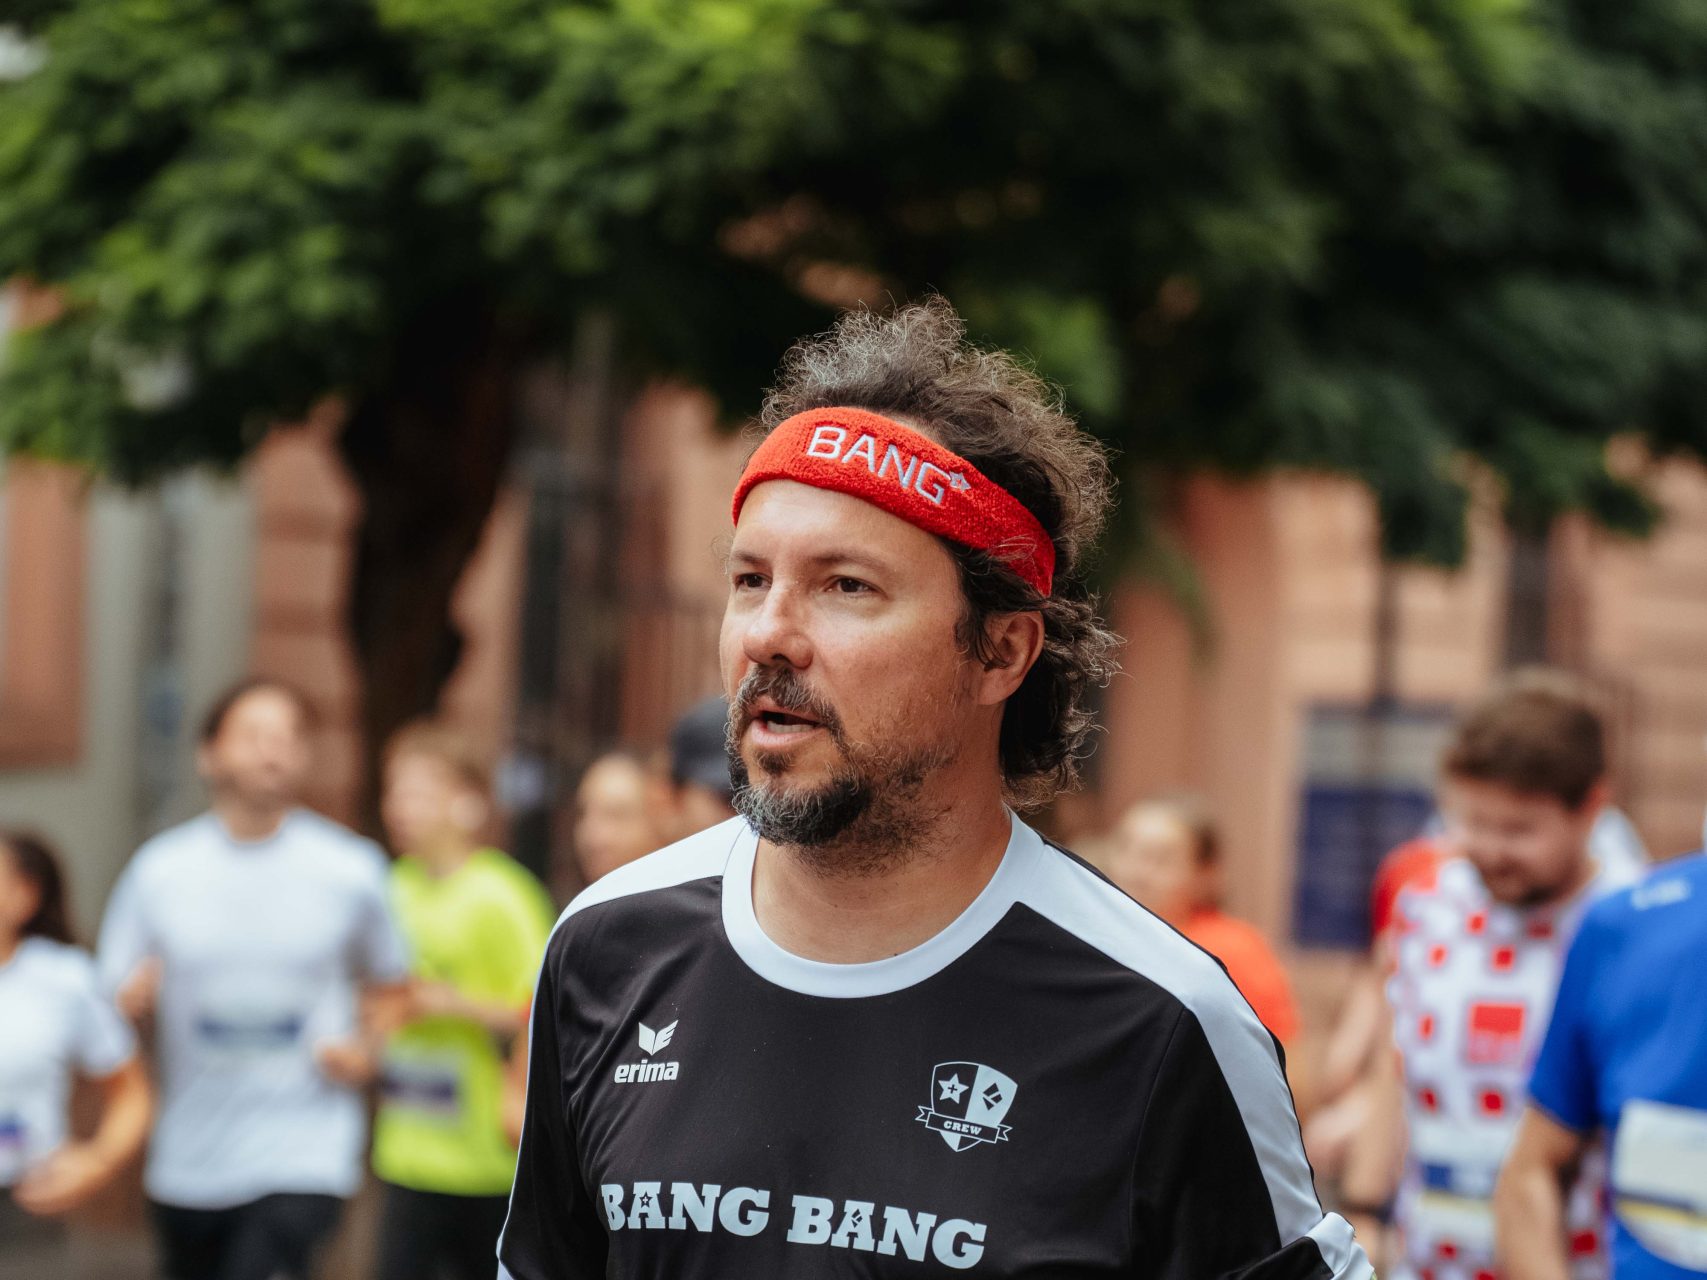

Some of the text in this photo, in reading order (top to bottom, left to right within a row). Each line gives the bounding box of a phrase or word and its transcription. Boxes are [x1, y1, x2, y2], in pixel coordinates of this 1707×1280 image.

[806, 425, 952, 505] BANG
[614, 1058, 680, 1084] erima
[943, 1120, 982, 1136] CREW
[601, 1181, 988, 1270] BANG BANG
